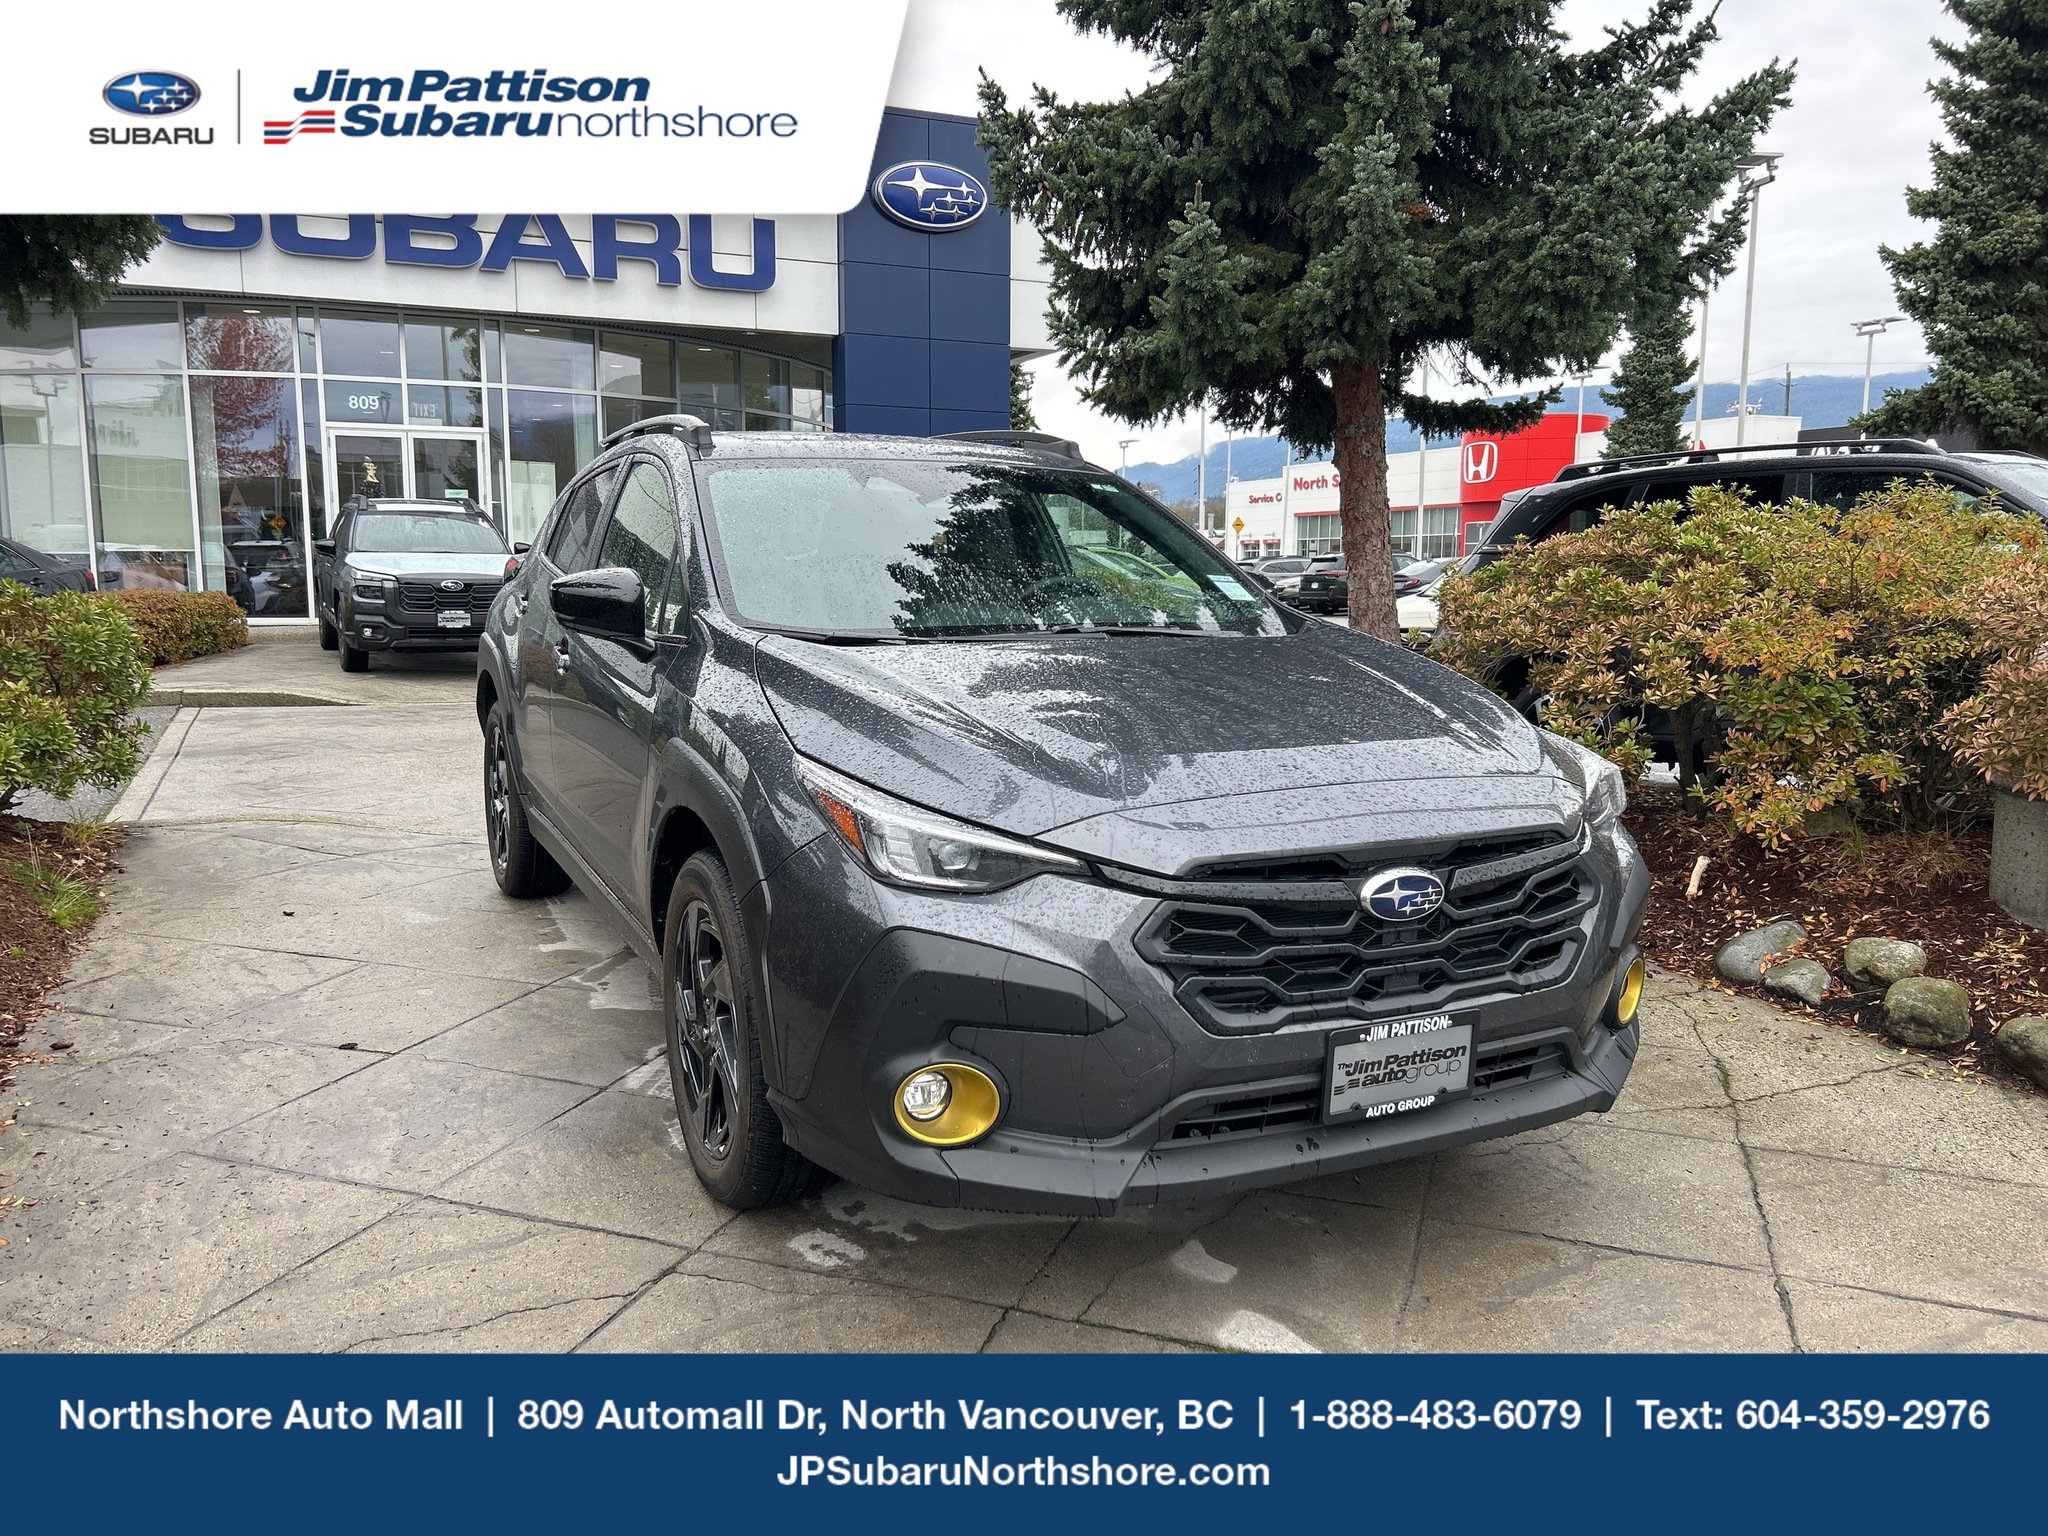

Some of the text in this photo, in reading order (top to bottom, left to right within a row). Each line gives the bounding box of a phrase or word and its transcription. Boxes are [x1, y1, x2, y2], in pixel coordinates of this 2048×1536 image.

[348, 394, 380, 410] 809
[1293, 475, 1328, 491] North
[1248, 494, 1274, 504] Service
[1366, 1015, 1449, 1042] JIM PATTISON
[1345, 1058, 1382, 1076] Jim
[1383, 1045, 1467, 1069] Pattison
[1366, 1095, 1435, 1117] AUTO GROUP
